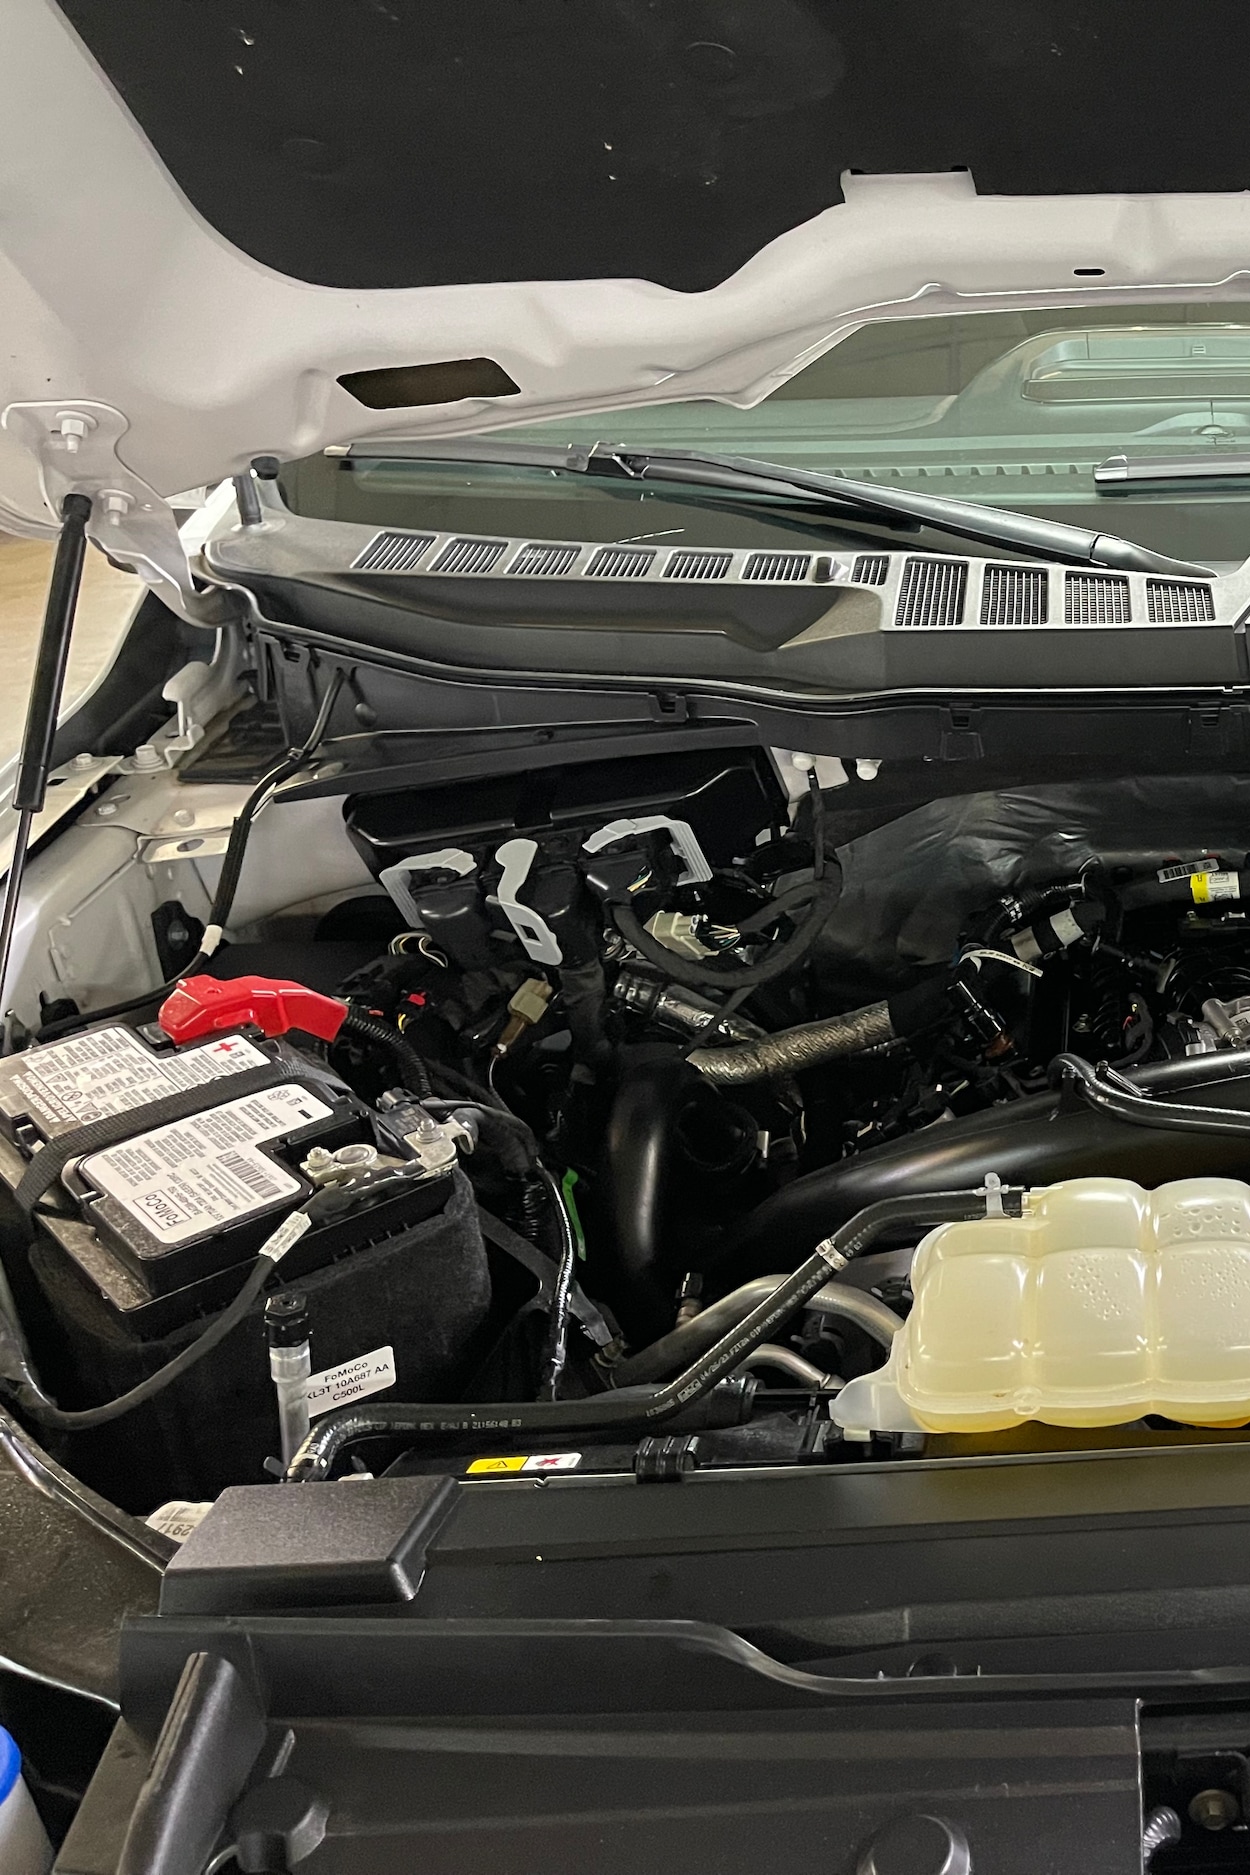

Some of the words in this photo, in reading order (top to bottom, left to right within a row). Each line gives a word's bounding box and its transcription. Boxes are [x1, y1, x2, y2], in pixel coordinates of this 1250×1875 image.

[145, 1194, 181, 1226] FoMoCo
[324, 1362, 368, 1382] FoMoCo
[336, 1370, 371, 1389] 10A687
[375, 1363, 389, 1374] AA
[332, 1384, 365, 1401] C500L
